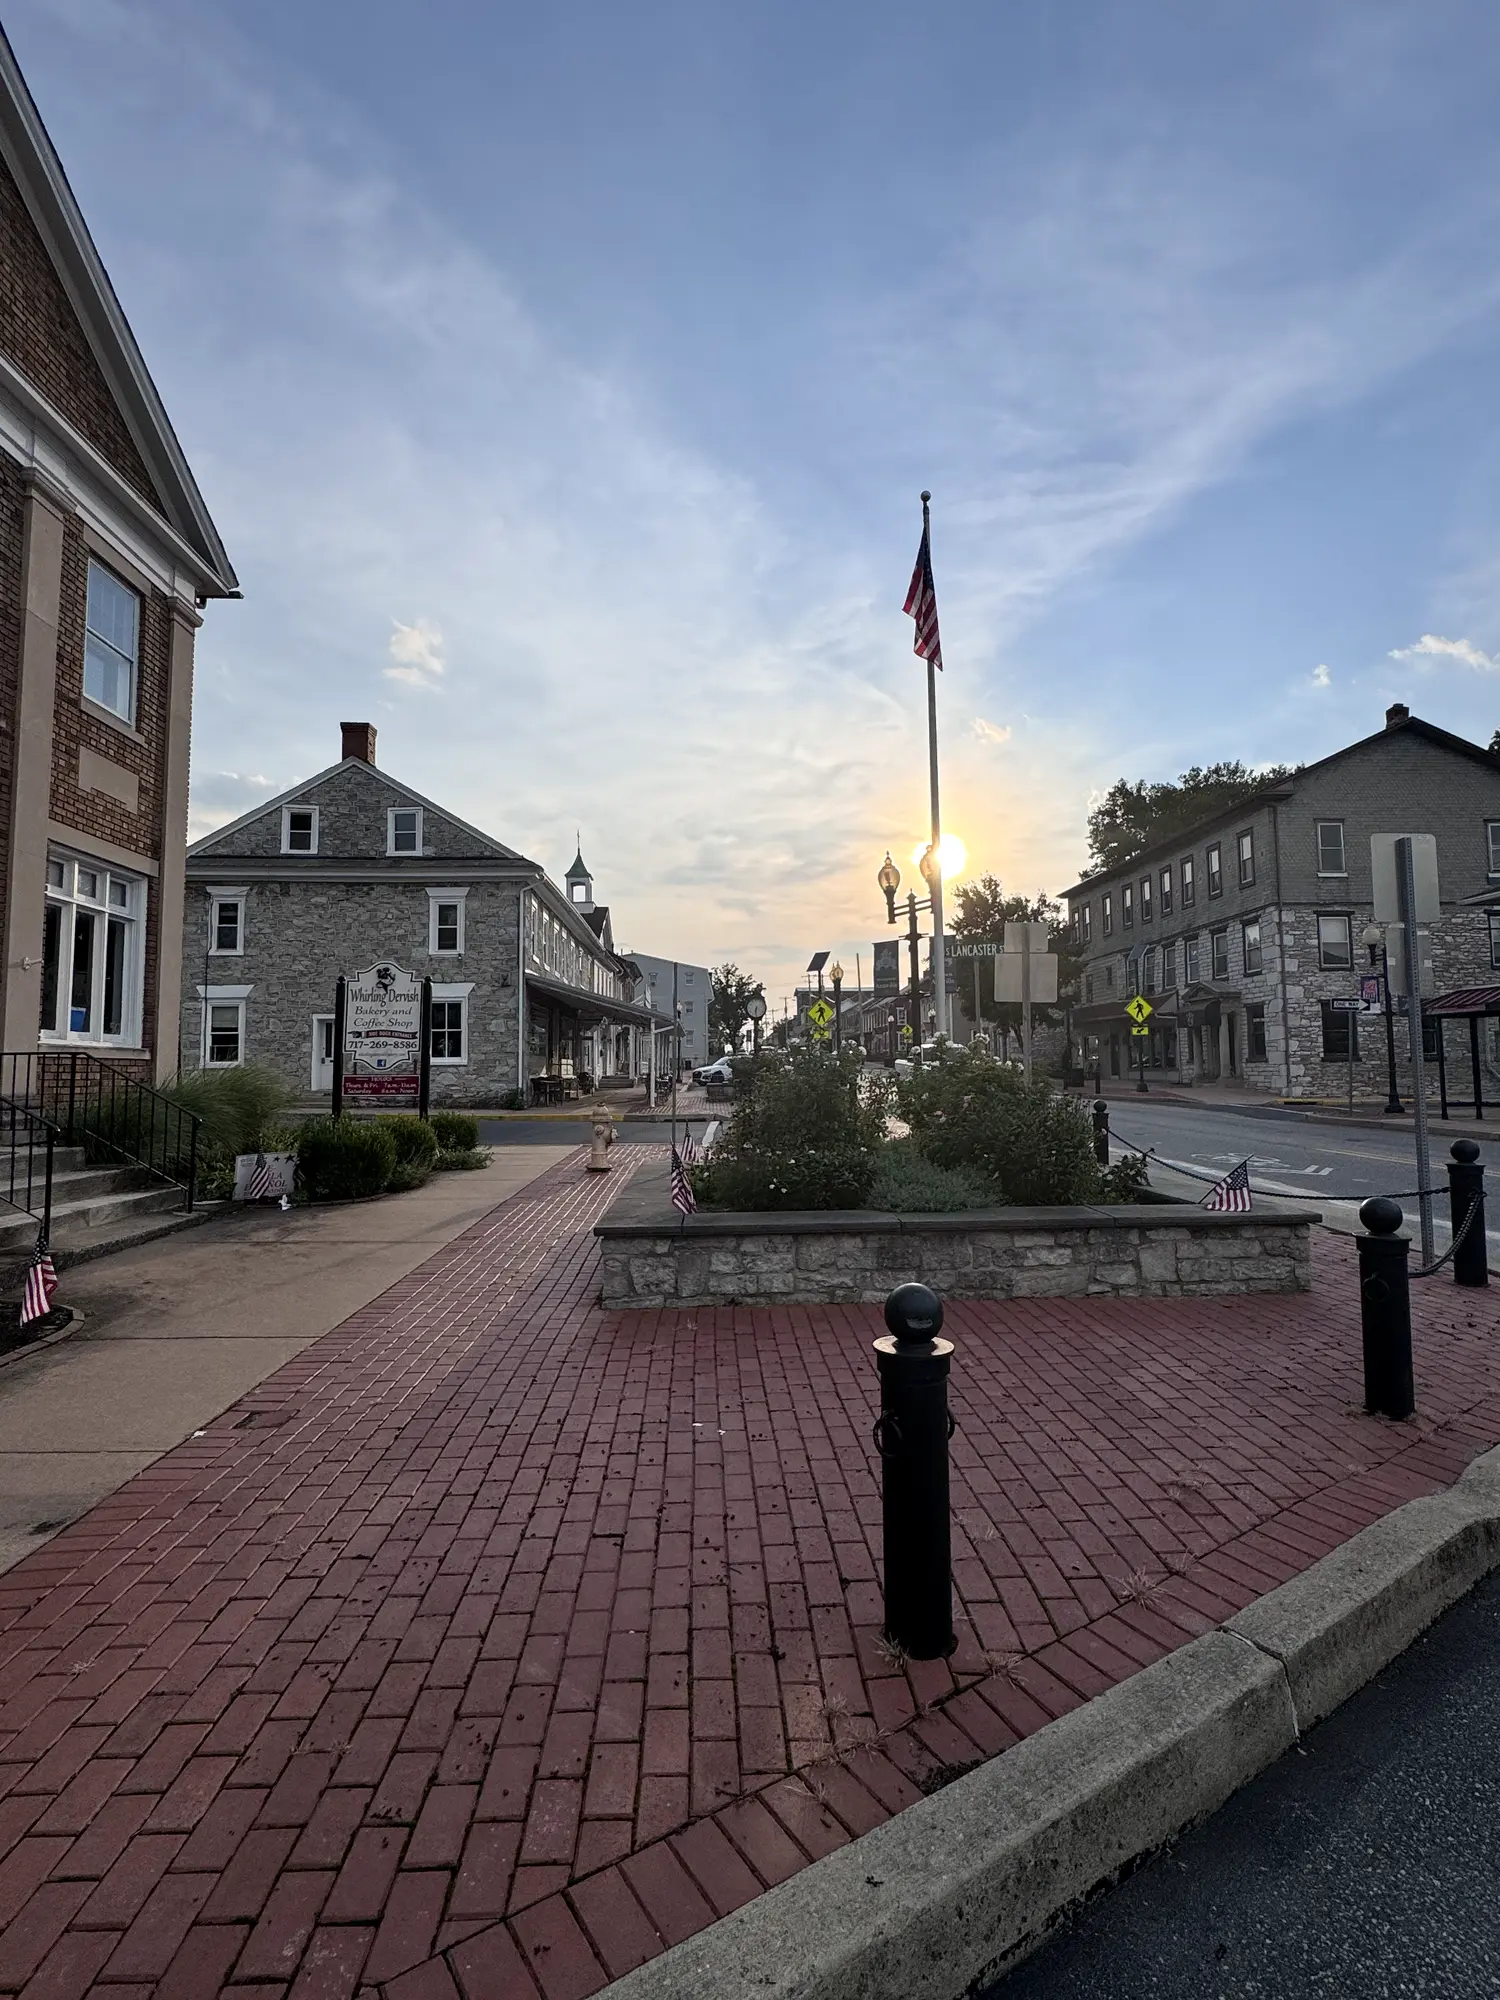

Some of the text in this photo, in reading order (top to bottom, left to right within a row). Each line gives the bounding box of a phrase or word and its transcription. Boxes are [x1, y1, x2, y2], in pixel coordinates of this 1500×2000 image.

[946, 947, 950, 956] S
[951, 943, 997, 957] LANCASTER
[350, 987, 419, 1007] Whirling Dervish
[355, 1006, 412, 1017] Bakery and
[354, 1018, 413, 1029] Coffee Shop
[392, 1031, 413, 1039] ENTRANCE
[348, 1040, 417, 1049] 717-269-8586
